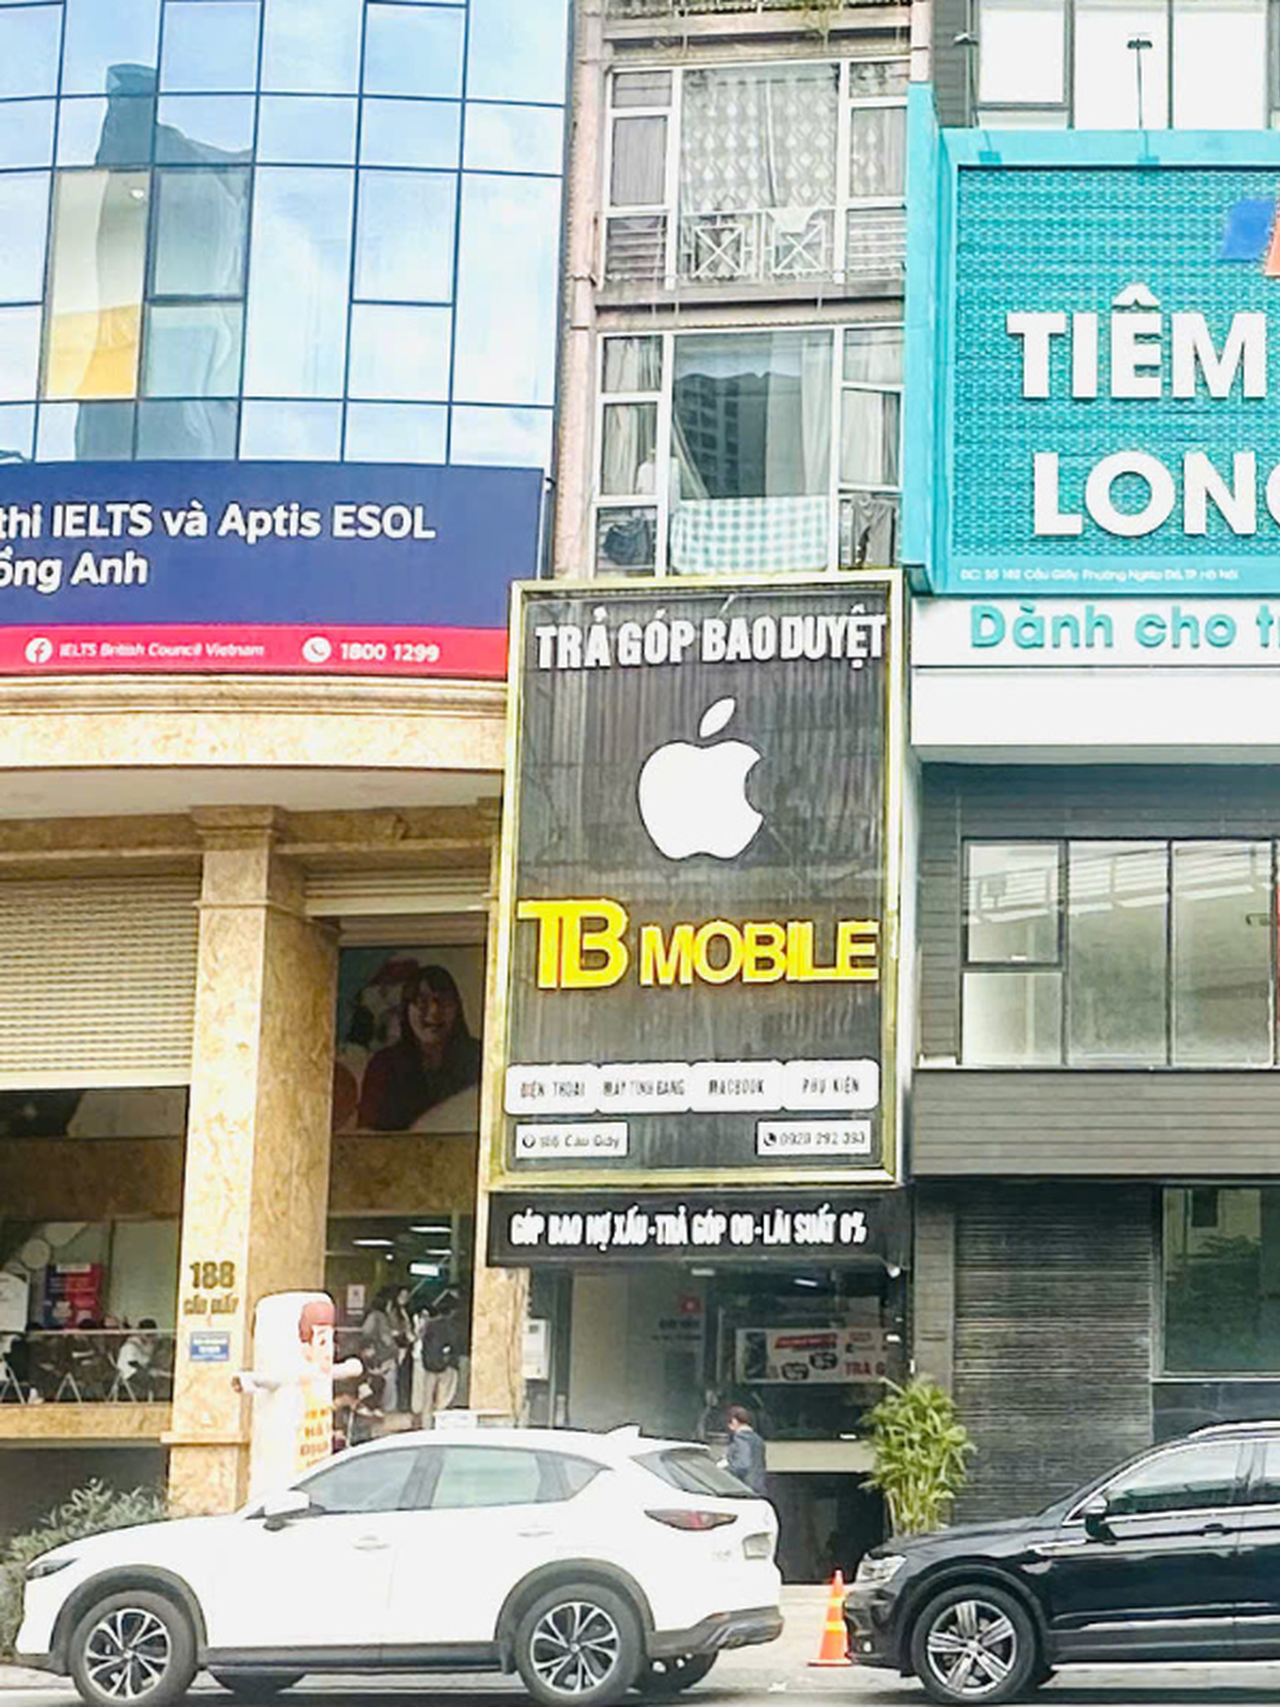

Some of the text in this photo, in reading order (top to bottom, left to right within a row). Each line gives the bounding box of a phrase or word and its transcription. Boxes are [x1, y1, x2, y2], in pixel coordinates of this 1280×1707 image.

[1006, 282, 1268, 400] TIÊM
[53, 503, 152, 537] IELTS
[162, 499, 208, 537] và
[217, 503, 322, 544] Aptis
[332, 504, 436, 539] ESOL
[70, 550, 148, 585] Anh
[536, 607, 611, 668] TRẢ
[618, 609, 695, 666] GÓP
[780, 603, 887, 669] DUYỆT
[970, 602, 1113, 648] Dành
[1135, 605, 1237, 648] cho
[59, 642, 264, 658] IELTS British Council Vietnam
[340, 642, 441, 662] 1800 1299
[517, 899, 880, 989] TB MOBILE
[190, 1261, 235, 1289] 188
